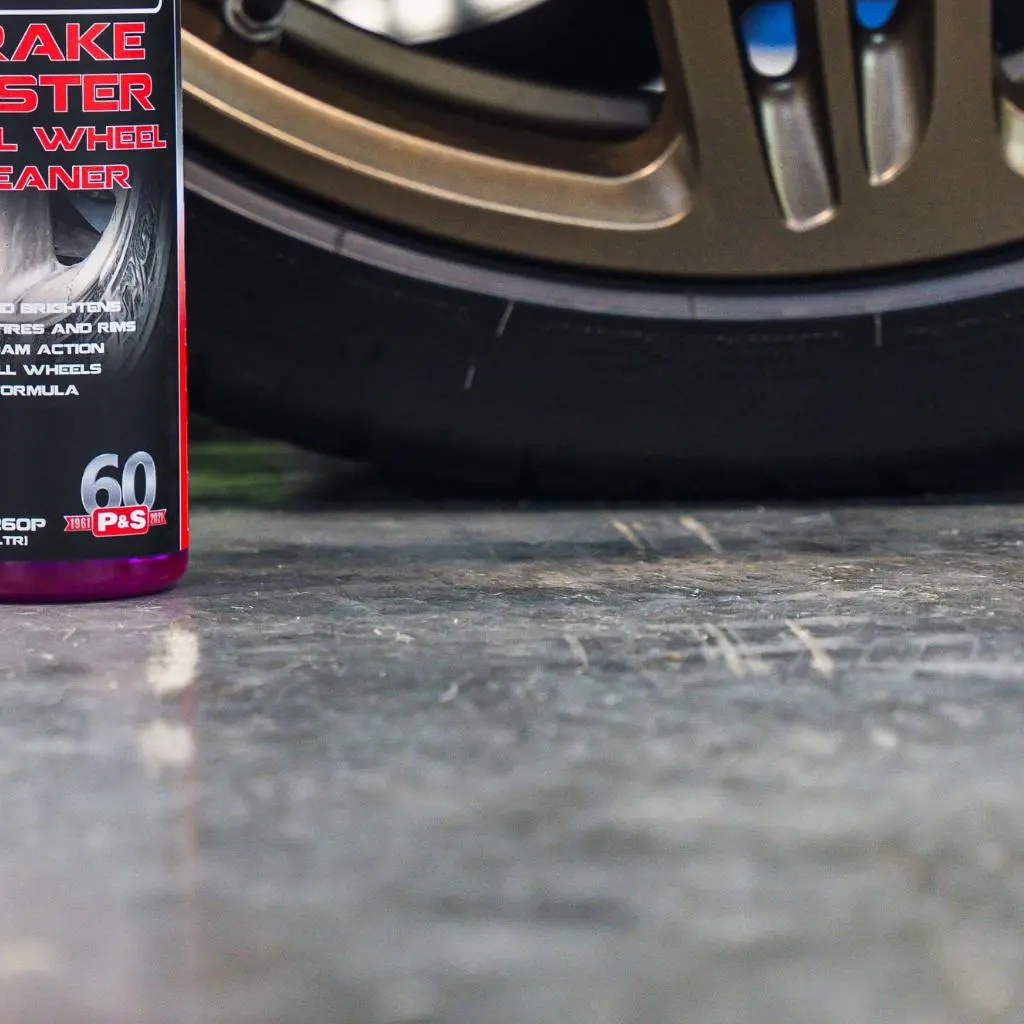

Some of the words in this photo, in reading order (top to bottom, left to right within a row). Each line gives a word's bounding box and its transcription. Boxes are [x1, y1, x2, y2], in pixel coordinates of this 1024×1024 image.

[33, 124, 167, 152] WHEEL
[20, 300, 122, 314] BRIGHTENS
[50, 322, 93, 334] AND
[97, 320, 137, 333] RIMS
[37, 342, 105, 355] ACTION
[23, 363, 102, 376] WHEELS
[80, 451, 157, 515] 60
[69, 517, 91, 530] 1961
[97, 509, 147, 532] P&S
